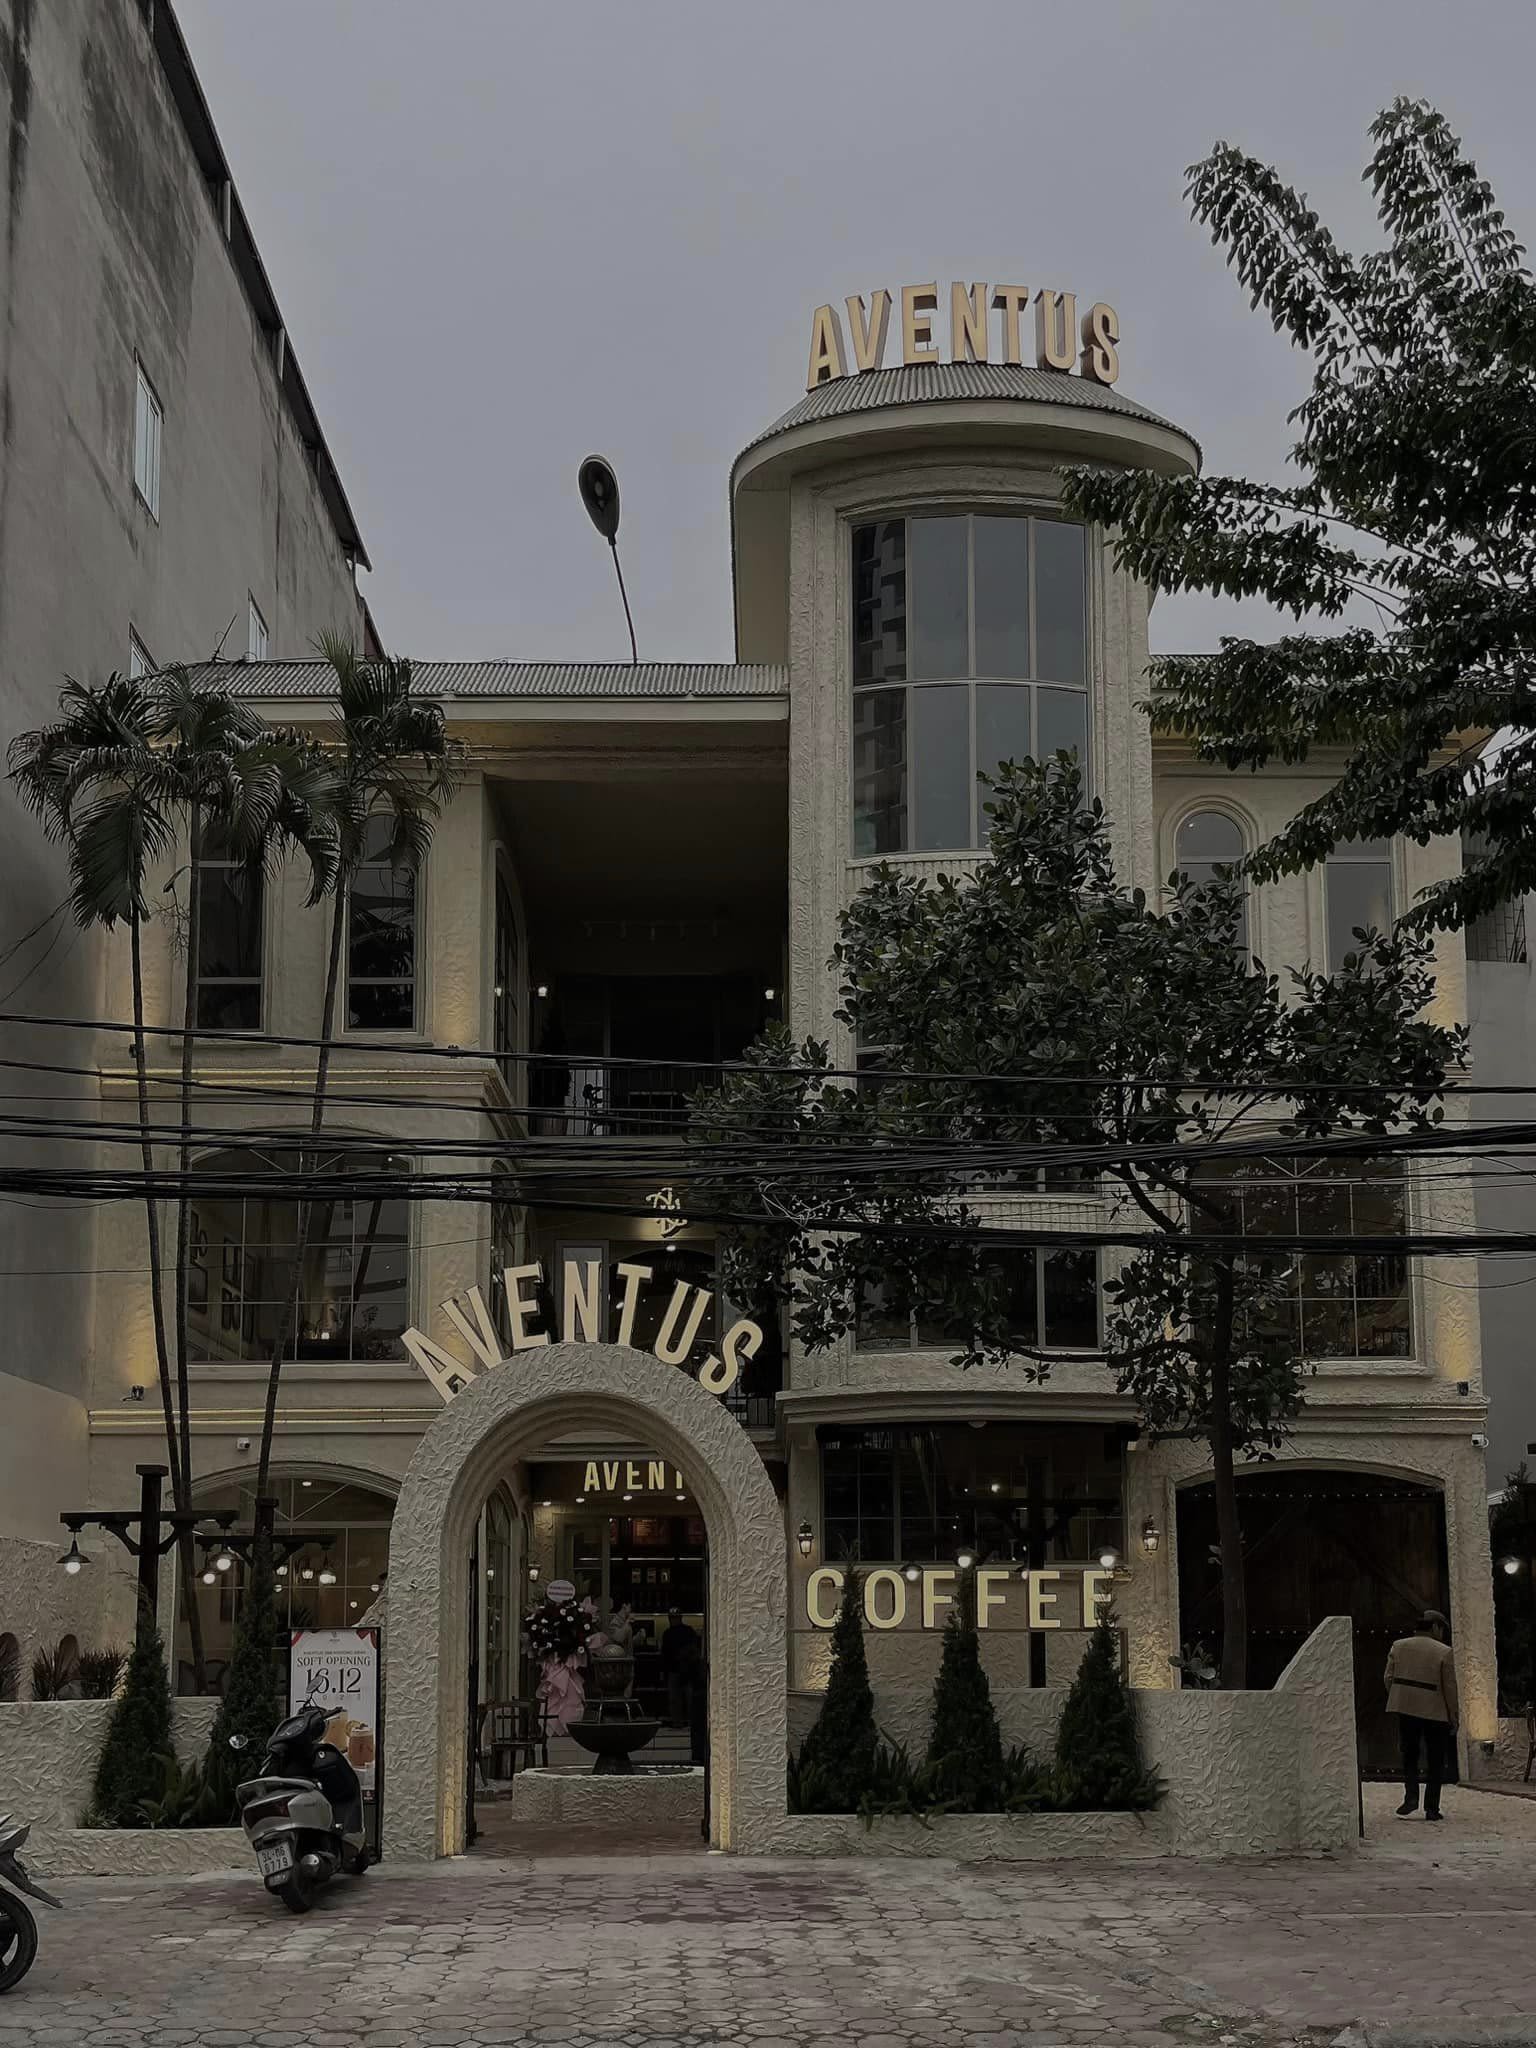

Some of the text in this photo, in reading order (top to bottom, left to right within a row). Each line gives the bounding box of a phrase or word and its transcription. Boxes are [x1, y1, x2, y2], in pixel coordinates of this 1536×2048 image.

[806, 281, 1120, 393] AVENTUS
[400, 1261, 764, 1404] AVENTUS
[806, 1568, 1114, 1629] COFFEE
[297, 1656, 371, 1667] SOFT OPENING
[306, 1667, 362, 1694] 16.12
